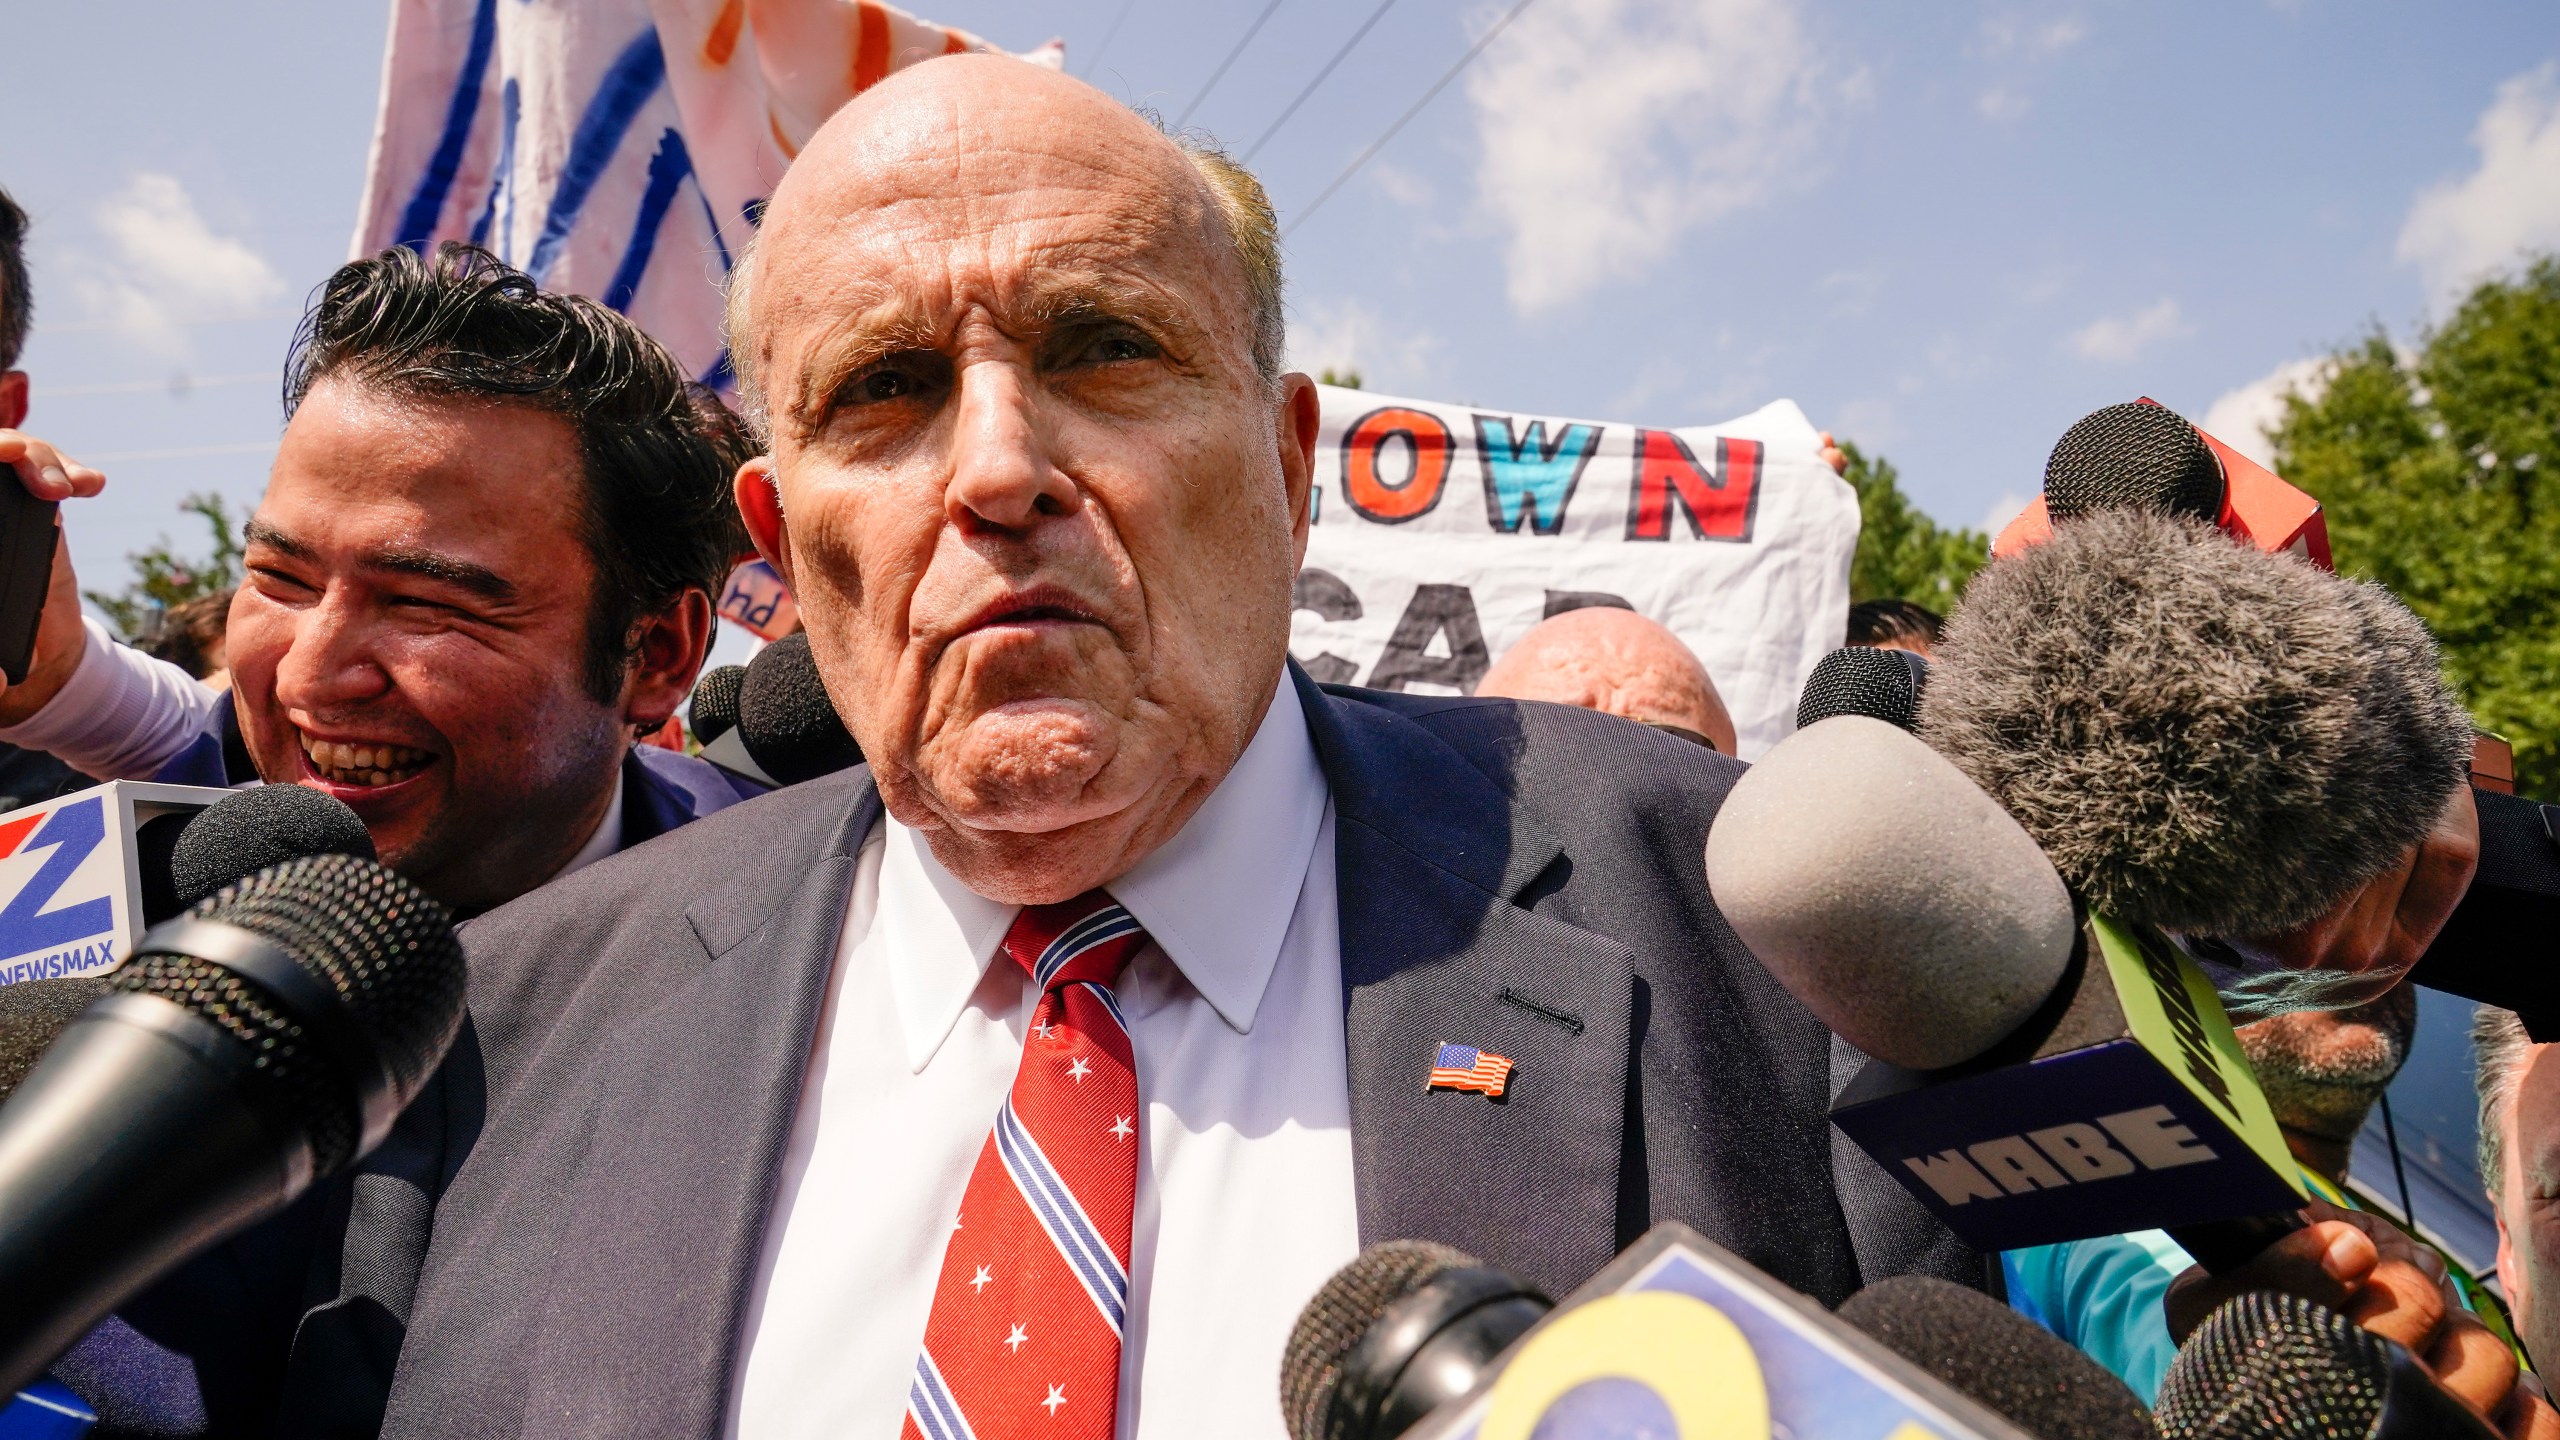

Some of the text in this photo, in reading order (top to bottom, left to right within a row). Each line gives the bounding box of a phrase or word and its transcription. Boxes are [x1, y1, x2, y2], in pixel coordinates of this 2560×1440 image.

[1311, 406, 1764, 543] OWN
[0, 940, 115, 986] NEWSMAX
[1902, 1104, 2218, 1206] WABE
